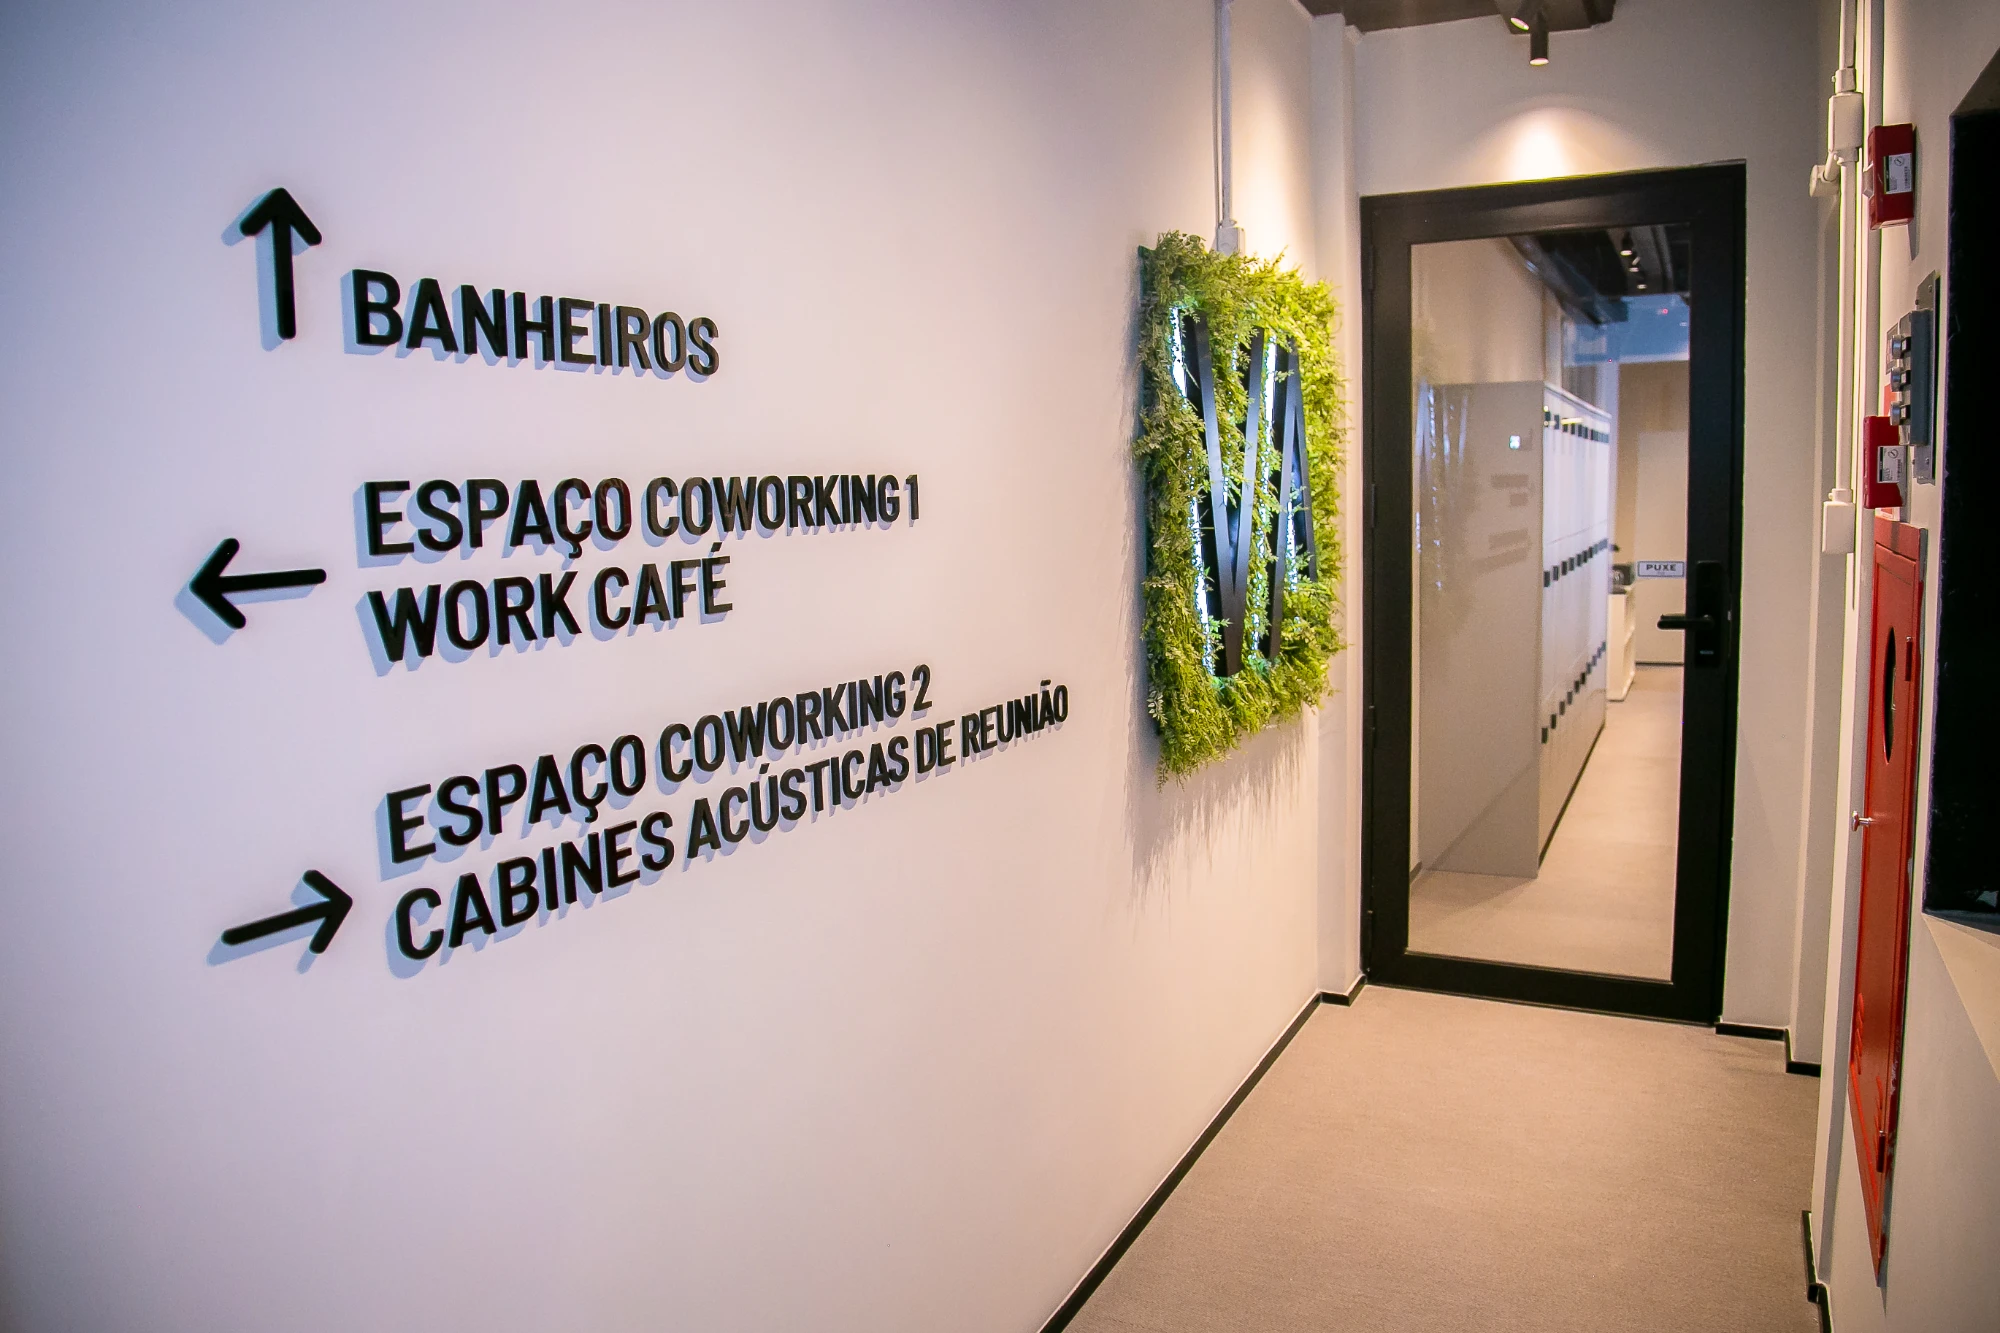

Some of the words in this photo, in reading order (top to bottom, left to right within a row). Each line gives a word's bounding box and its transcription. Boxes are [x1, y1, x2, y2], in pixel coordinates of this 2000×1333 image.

[352, 269, 719, 376] BANHEIROS
[364, 478, 632, 558] ESPAÇO
[645, 474, 900, 538] COWORKING
[905, 474, 919, 522] 1
[1646, 563, 1676, 571] PUXE
[367, 570, 583, 663] WORK
[594, 542, 733, 630] CAFÉ
[386, 734, 647, 864] ESPAÇO
[659, 670, 907, 784] COWORKING
[911, 664, 933, 712] 2
[395, 811, 675, 960] CABINES
[686, 735, 910, 859] ACÚSTICAS
[915, 719, 957, 774] DE
[961, 680, 1069, 758] REUNIÃO
